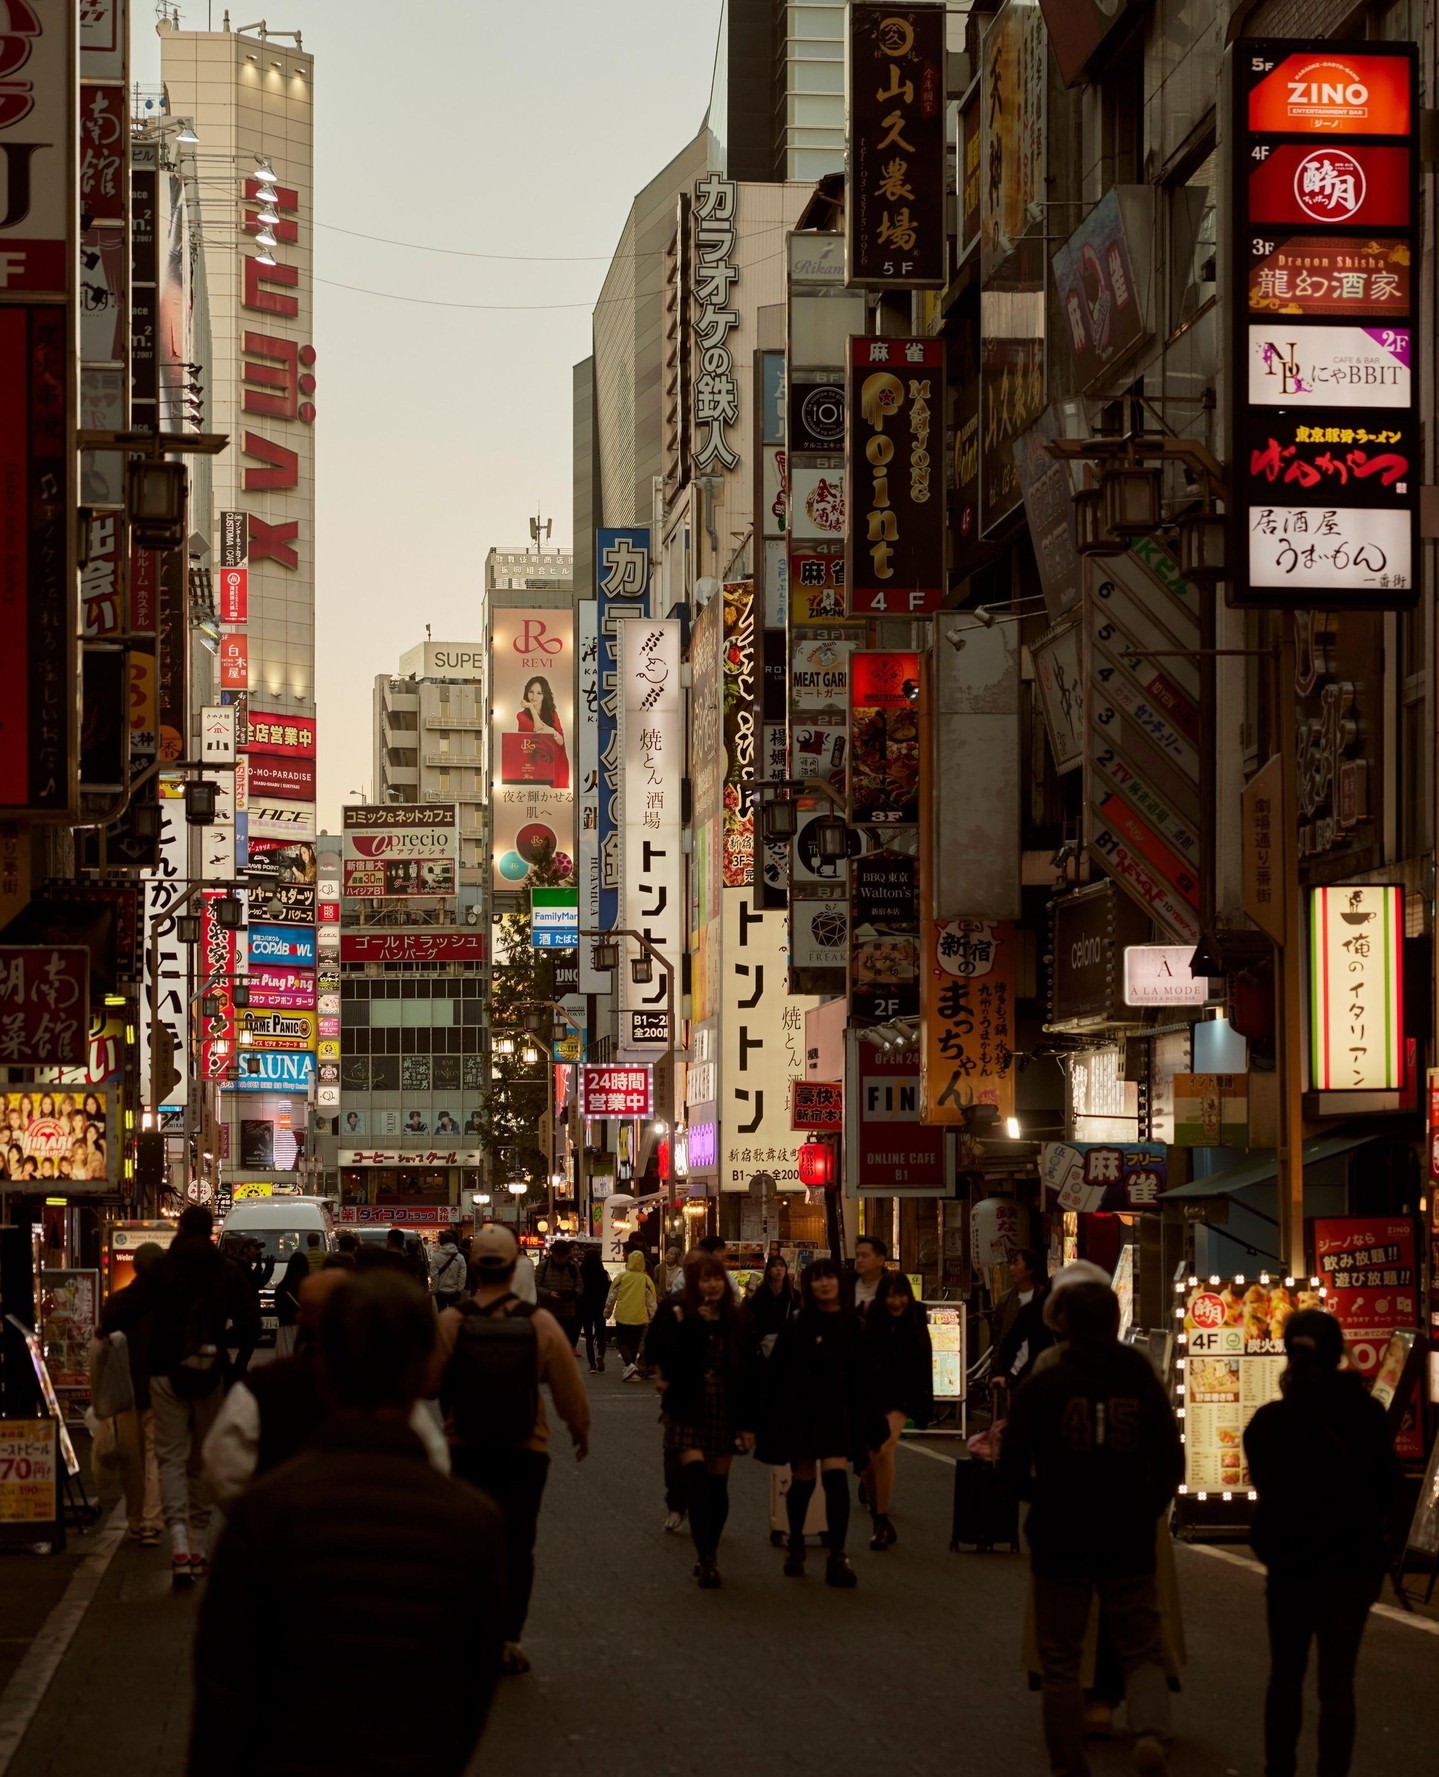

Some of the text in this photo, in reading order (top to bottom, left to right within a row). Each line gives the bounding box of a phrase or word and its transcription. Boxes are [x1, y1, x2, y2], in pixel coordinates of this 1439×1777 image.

[1251, 57, 1274, 72] 5F
[1287, 83, 1368, 105] ZINO
[874, 64, 920, 252] 山久農場
[1251, 146, 1270, 160] 4F
[1252, 239, 1274, 255] 3F
[1278, 254, 1385, 268] Dragon Shisha
[693, 171, 740, 470] カラオケの鉄人
[1381, 330, 1408, 353] 2F
[868, 341, 925, 363] 麻雀
[861, 371, 905, 580] Point
[1252, 509, 1342, 536] 居酒屋
[1099, 581, 1114, 598] 6
[1099, 623, 1116, 640] 5
[522, 658, 553, 668] REVI
[794, 672, 820, 687] MEAT
[1098, 666, 1115, 682] 4
[1099, 708, 1114, 725] 3
[1098, 749, 1115, 767] 2
[503, 791, 573, 805] 夜を輝かせる
[347, 810, 453, 823] コミック&ネットカフェ
[526, 806, 552, 819] 肌へ
[372, 829, 448, 856] aprecio
[1096, 831, 1119, 855] B1
[862, 872, 886, 884] BBQ
[347, 887, 384, 895] ハイジアB1
[860, 886, 912, 899] Walton's
[639, 841, 667, 1004] トントン
[355, 936, 478, 949] ゴールドラッシュ
[539, 933, 551, 945] 酒
[940, 932, 993, 963] 新宿
[379, 948, 437, 960] ハンバーグ
[1170, 987, 1201, 996] MODE
[873, 1000, 899, 1016] 2F
[1342, 933, 1371, 1088] 俺のイタリアン
[272, 1014, 299, 1034] PANIC
[735, 901, 764, 1133] トントン
[238, 1053, 314, 1081] SAUNA
[588, 1073, 645, 1091] 24時間
[588, 1092, 645, 1111] 営業中
[867, 1152, 937, 1165] ONLINE CAFE
[895, 1168, 909, 1181] B1
[1192, 1333, 1219, 1350] 4F
